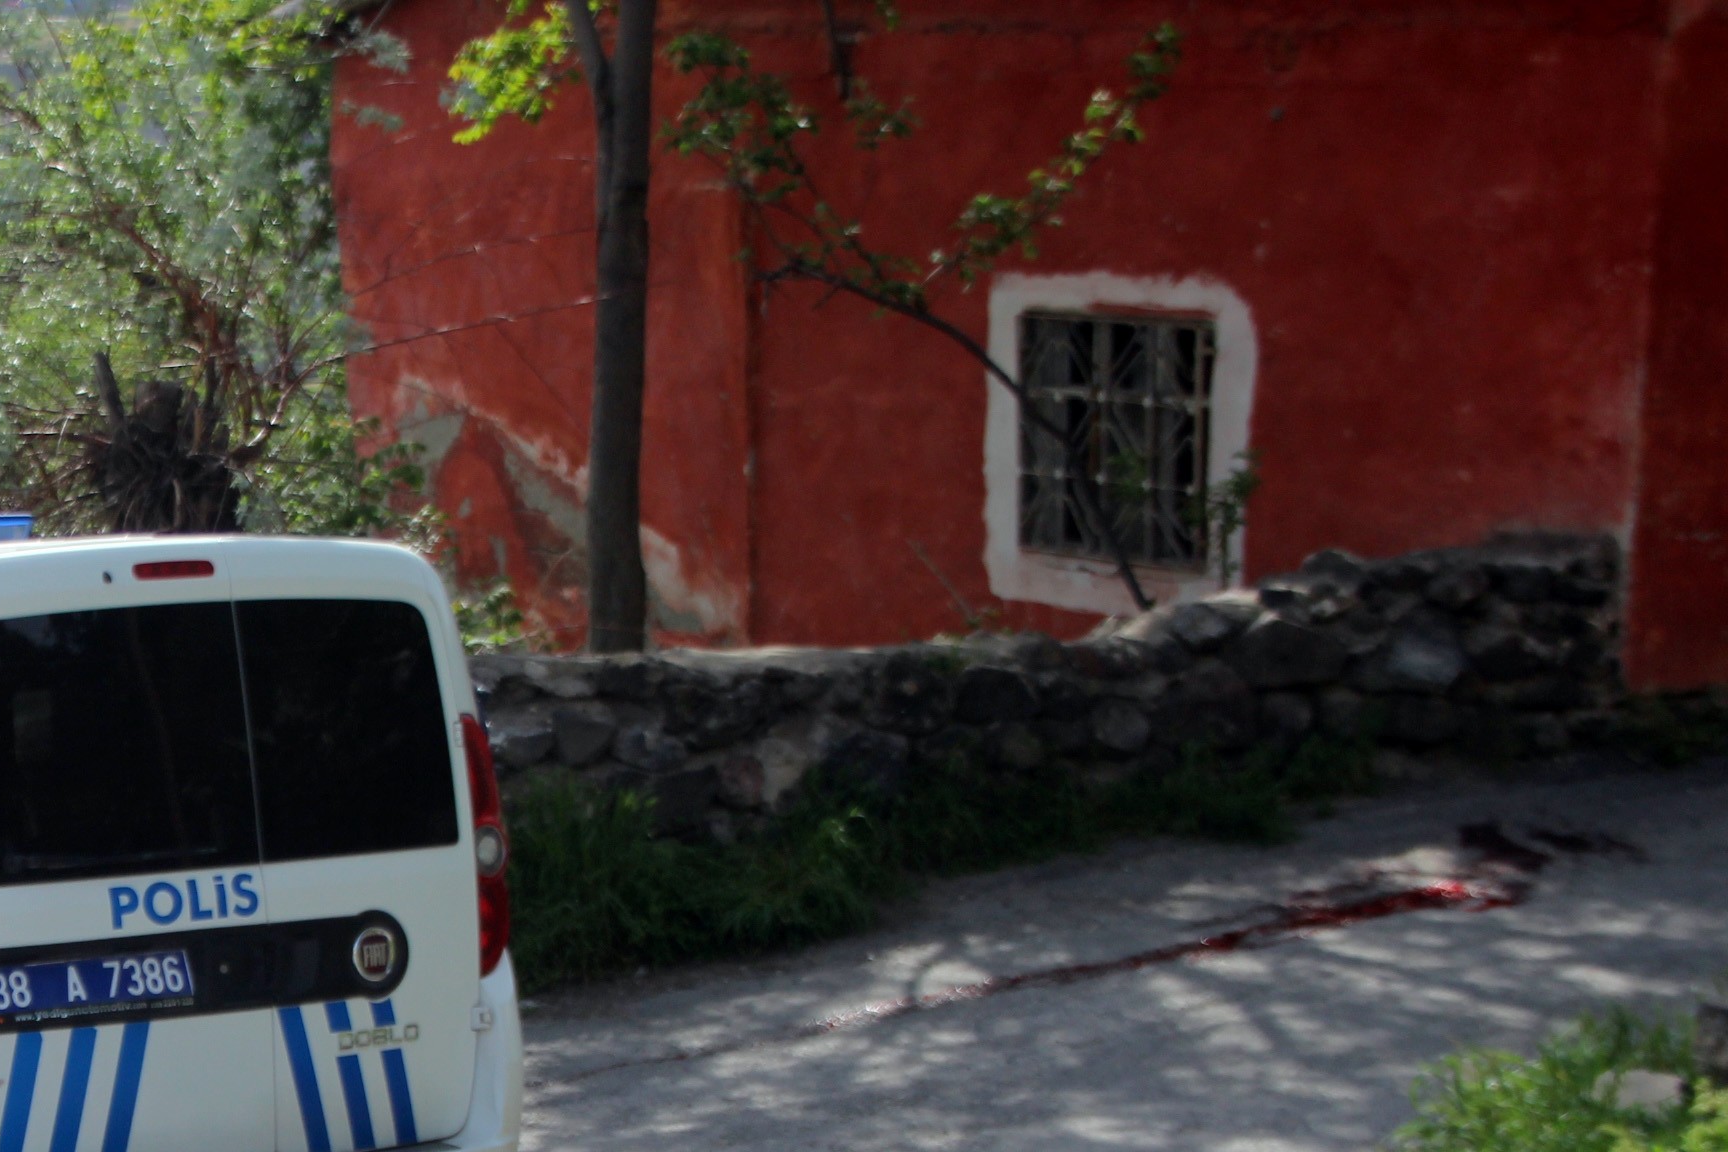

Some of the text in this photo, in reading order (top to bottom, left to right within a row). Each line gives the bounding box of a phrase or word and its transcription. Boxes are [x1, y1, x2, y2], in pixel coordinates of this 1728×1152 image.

[363, 942, 388, 969] FIAT
[67, 965, 88, 1003] A
[102, 954, 185, 999] 7386
[338, 1022, 419, 1051] DOBLO
